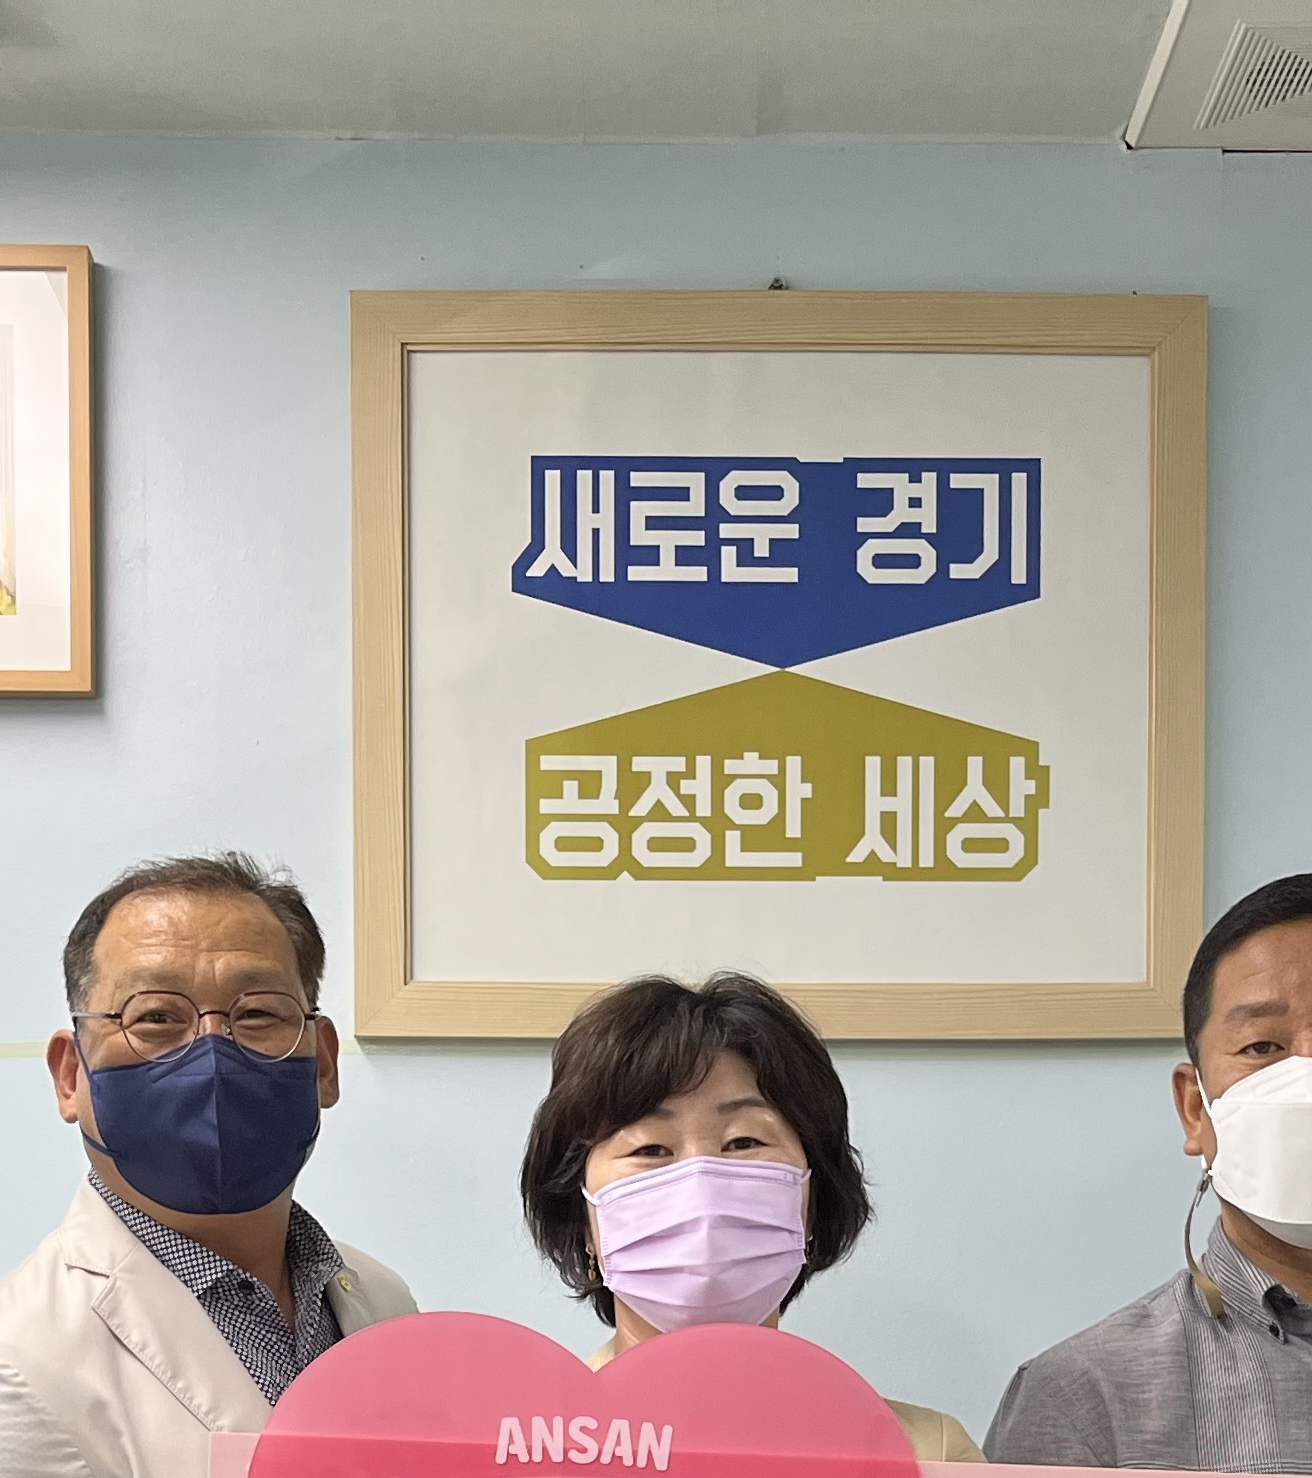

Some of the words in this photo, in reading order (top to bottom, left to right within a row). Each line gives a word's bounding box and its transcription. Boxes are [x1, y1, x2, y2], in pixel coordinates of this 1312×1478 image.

[525, 467, 801, 585] 새로운
[855, 470, 1029, 585] 경기
[537, 750, 813, 870] 공정한
[844, 753, 1036, 870] 세상
[494, 1414, 674, 1472] ANSAN
